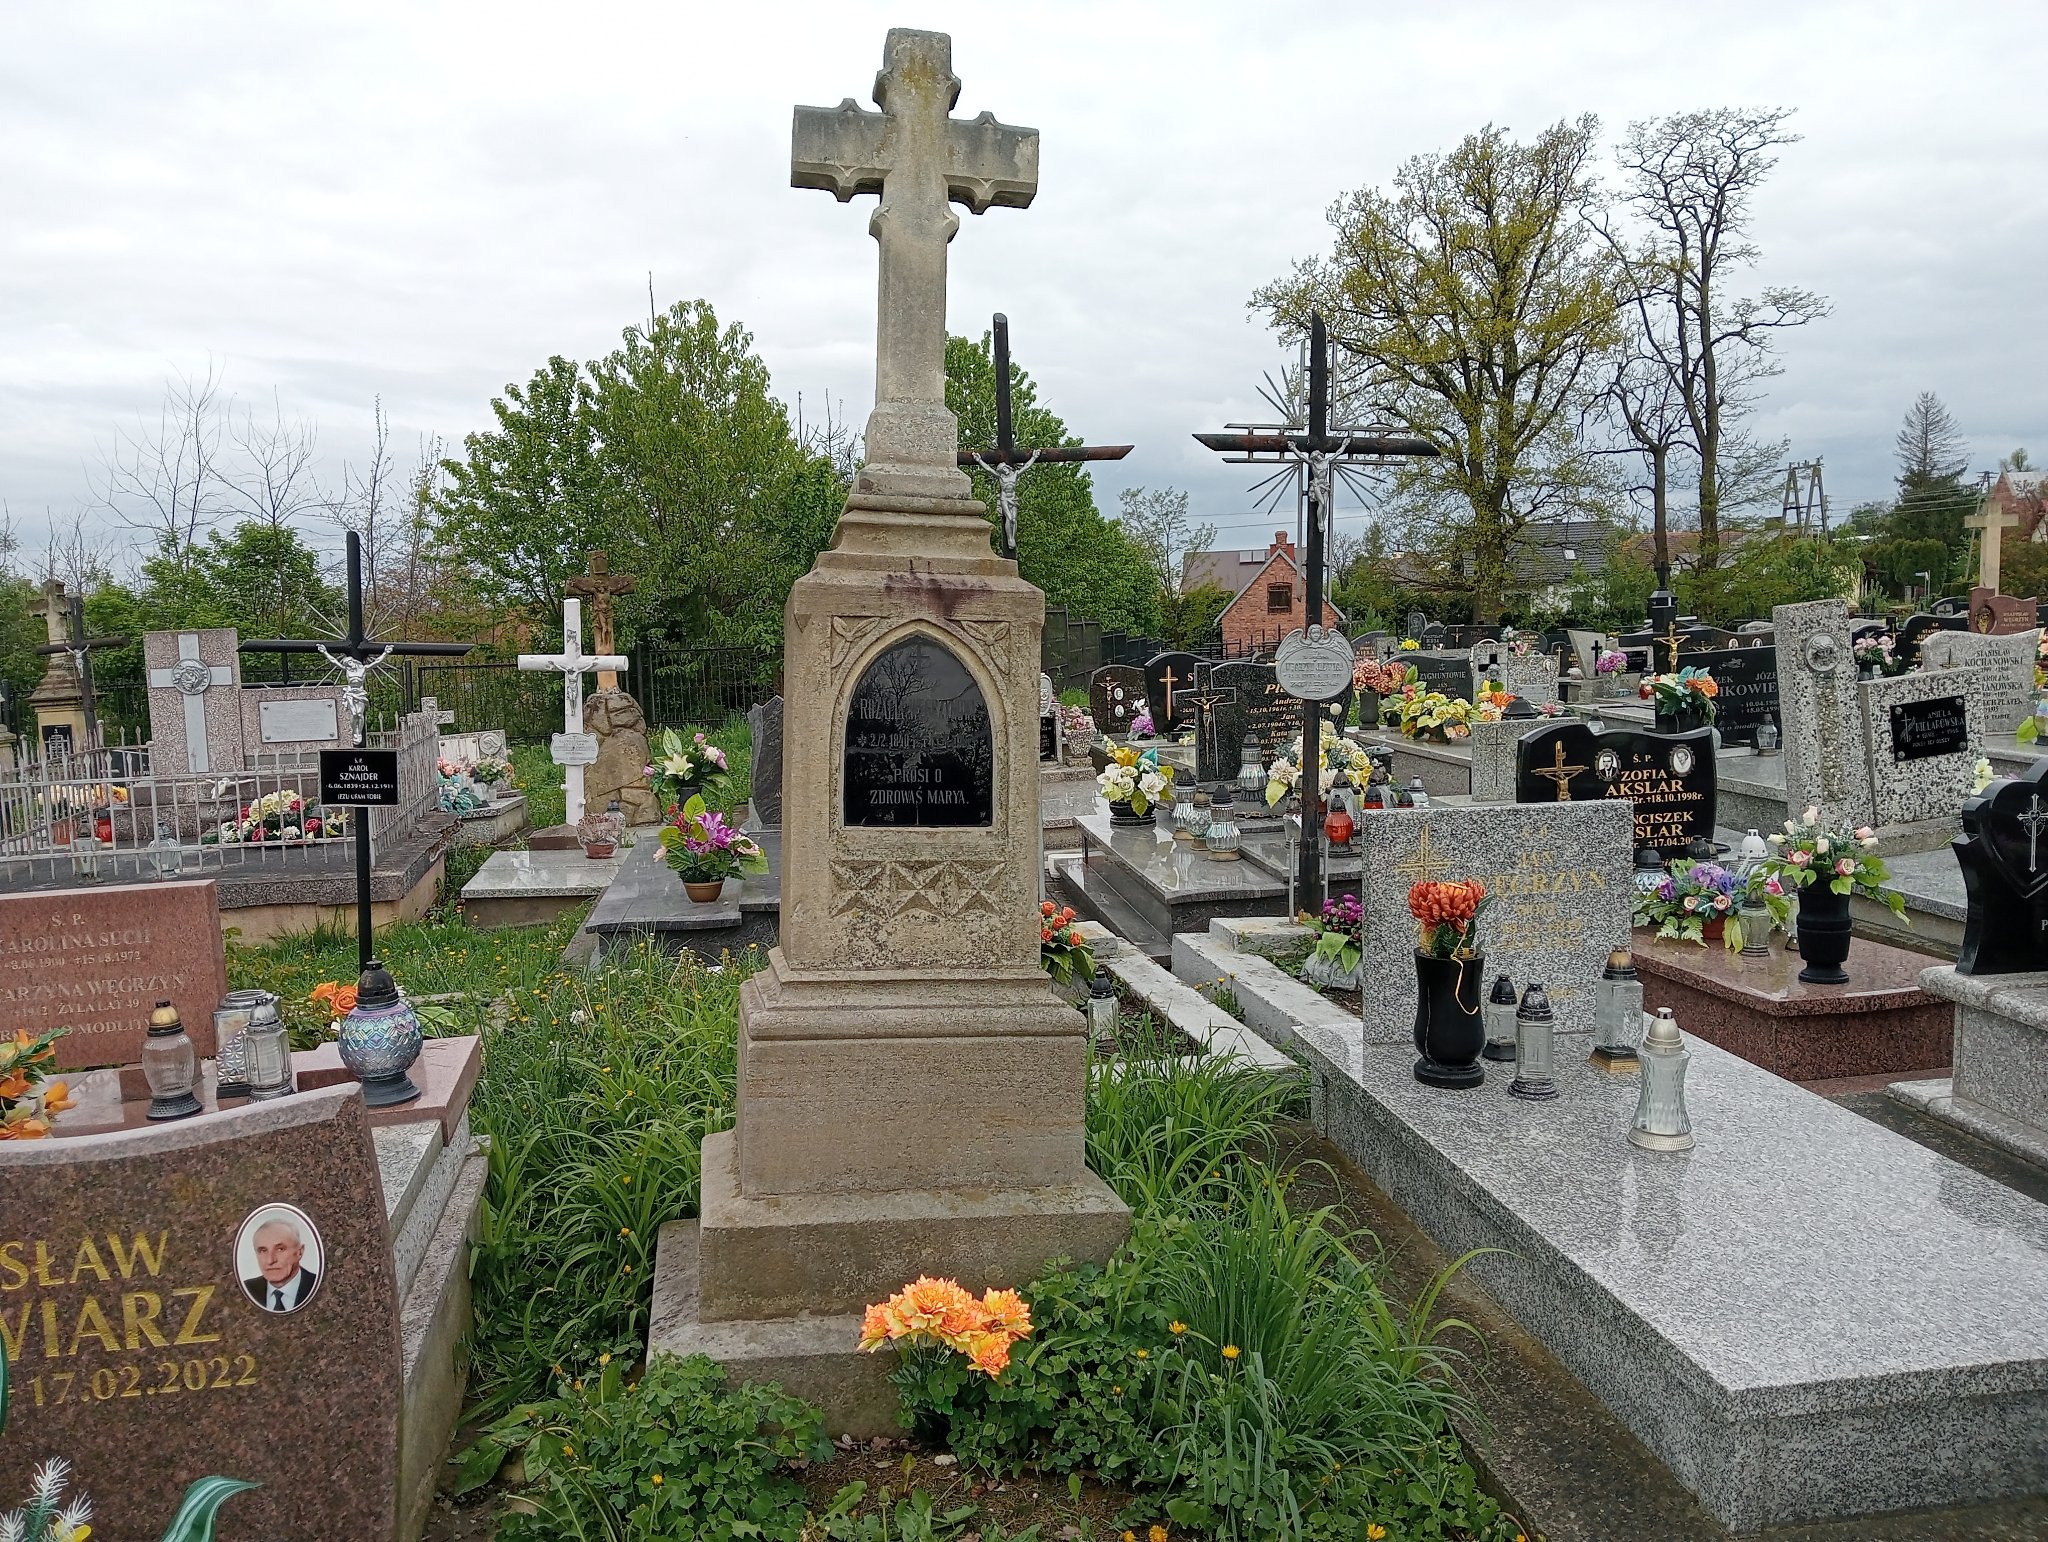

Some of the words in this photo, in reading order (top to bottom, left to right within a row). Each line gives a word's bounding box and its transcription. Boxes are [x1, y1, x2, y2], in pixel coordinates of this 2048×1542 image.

[1187, 673, 1195, 681] S
[340, 773, 378, 781] SZNAJDER
[894, 769, 929, 783] PROSI
[935, 769, 942, 783] O
[1621, 769, 1668, 781] ZOFIA
[870, 786, 923, 804] ZDROWAŚ
[1605, 780, 1684, 797] AKSLAR
[100, 930, 151, 947] SUCH
[0, 1230, 169, 1291] SŁAW
